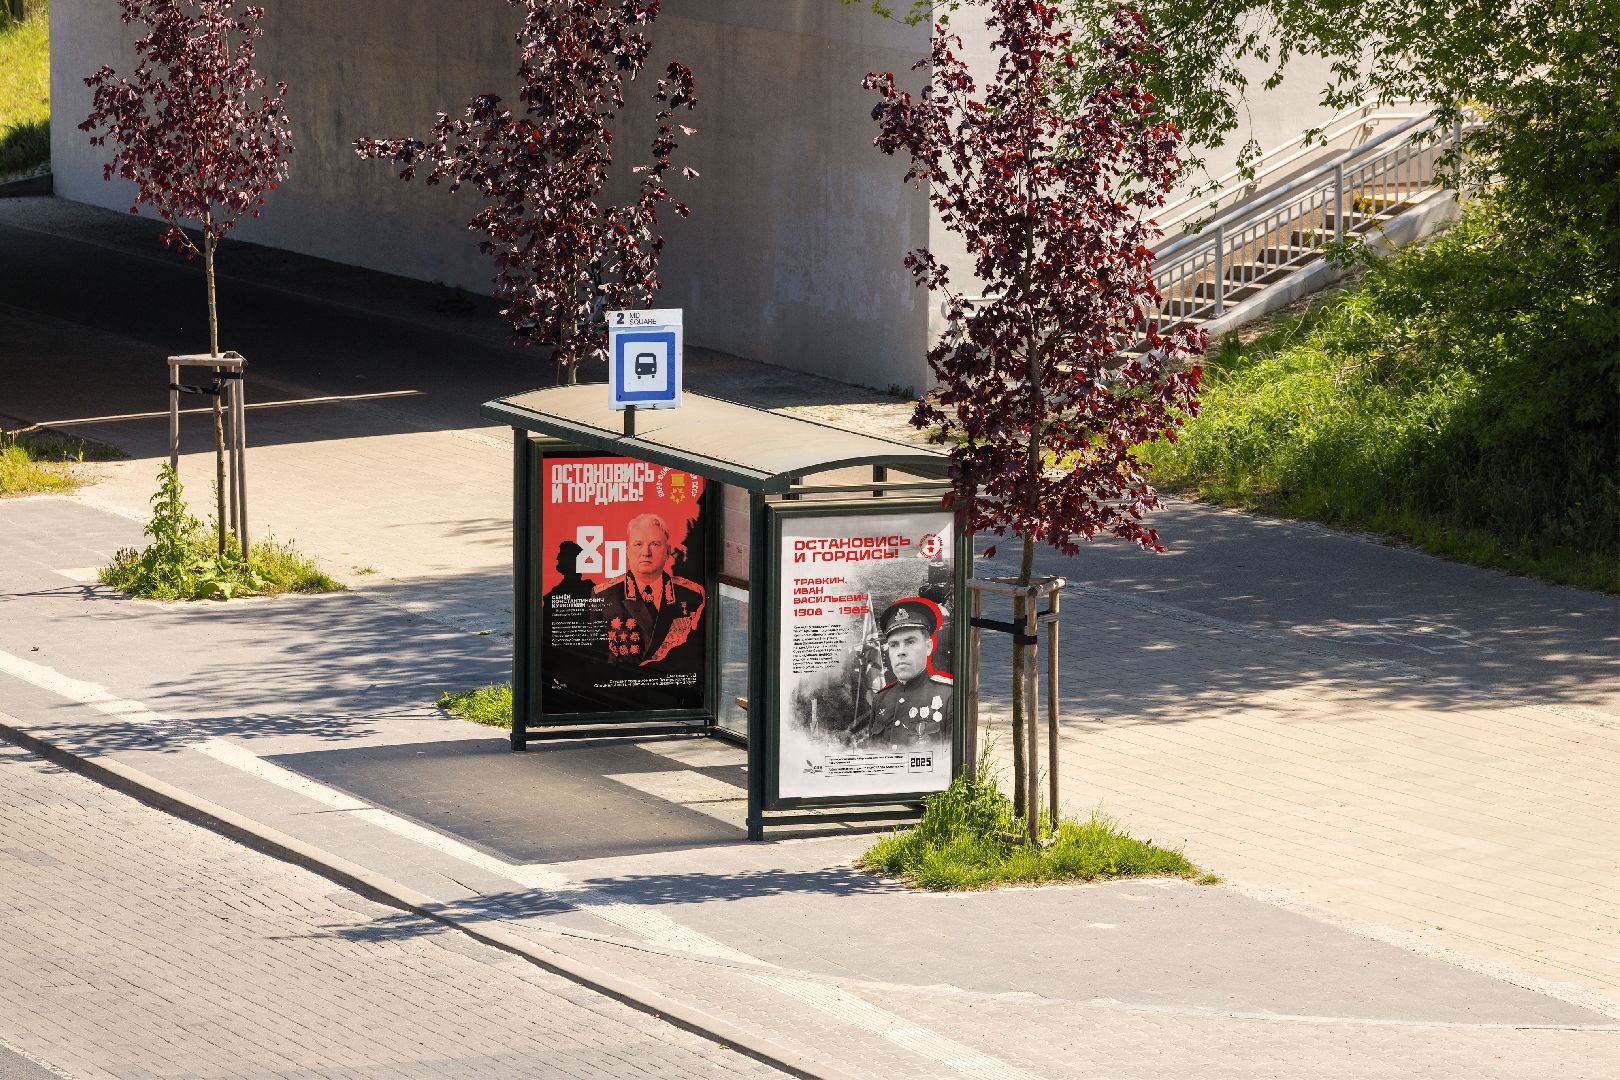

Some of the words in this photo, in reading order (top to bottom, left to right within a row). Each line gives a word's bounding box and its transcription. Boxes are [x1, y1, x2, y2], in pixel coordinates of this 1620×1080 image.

[616, 313, 625, 324] 2
[551, 463, 655, 484] ОСТАНОВИСЬ
[551, 482, 563, 504] И
[567, 481, 644, 506] ГОРДИСЬ!
[794, 535, 911, 551] ОСТАНОВИСЬ
[794, 553, 805, 563] И
[812, 548, 899, 562] ГОРДИСЬ!
[793, 576, 848, 586] ТРАВКИН,
[793, 586, 824, 595] ИВАН
[793, 594, 869, 605] ВАСИЛЬЕВИЧ
[793, 607, 823, 617] 1908
[838, 605, 870, 616] 1985
[910, 757, 932, 768] 2025
